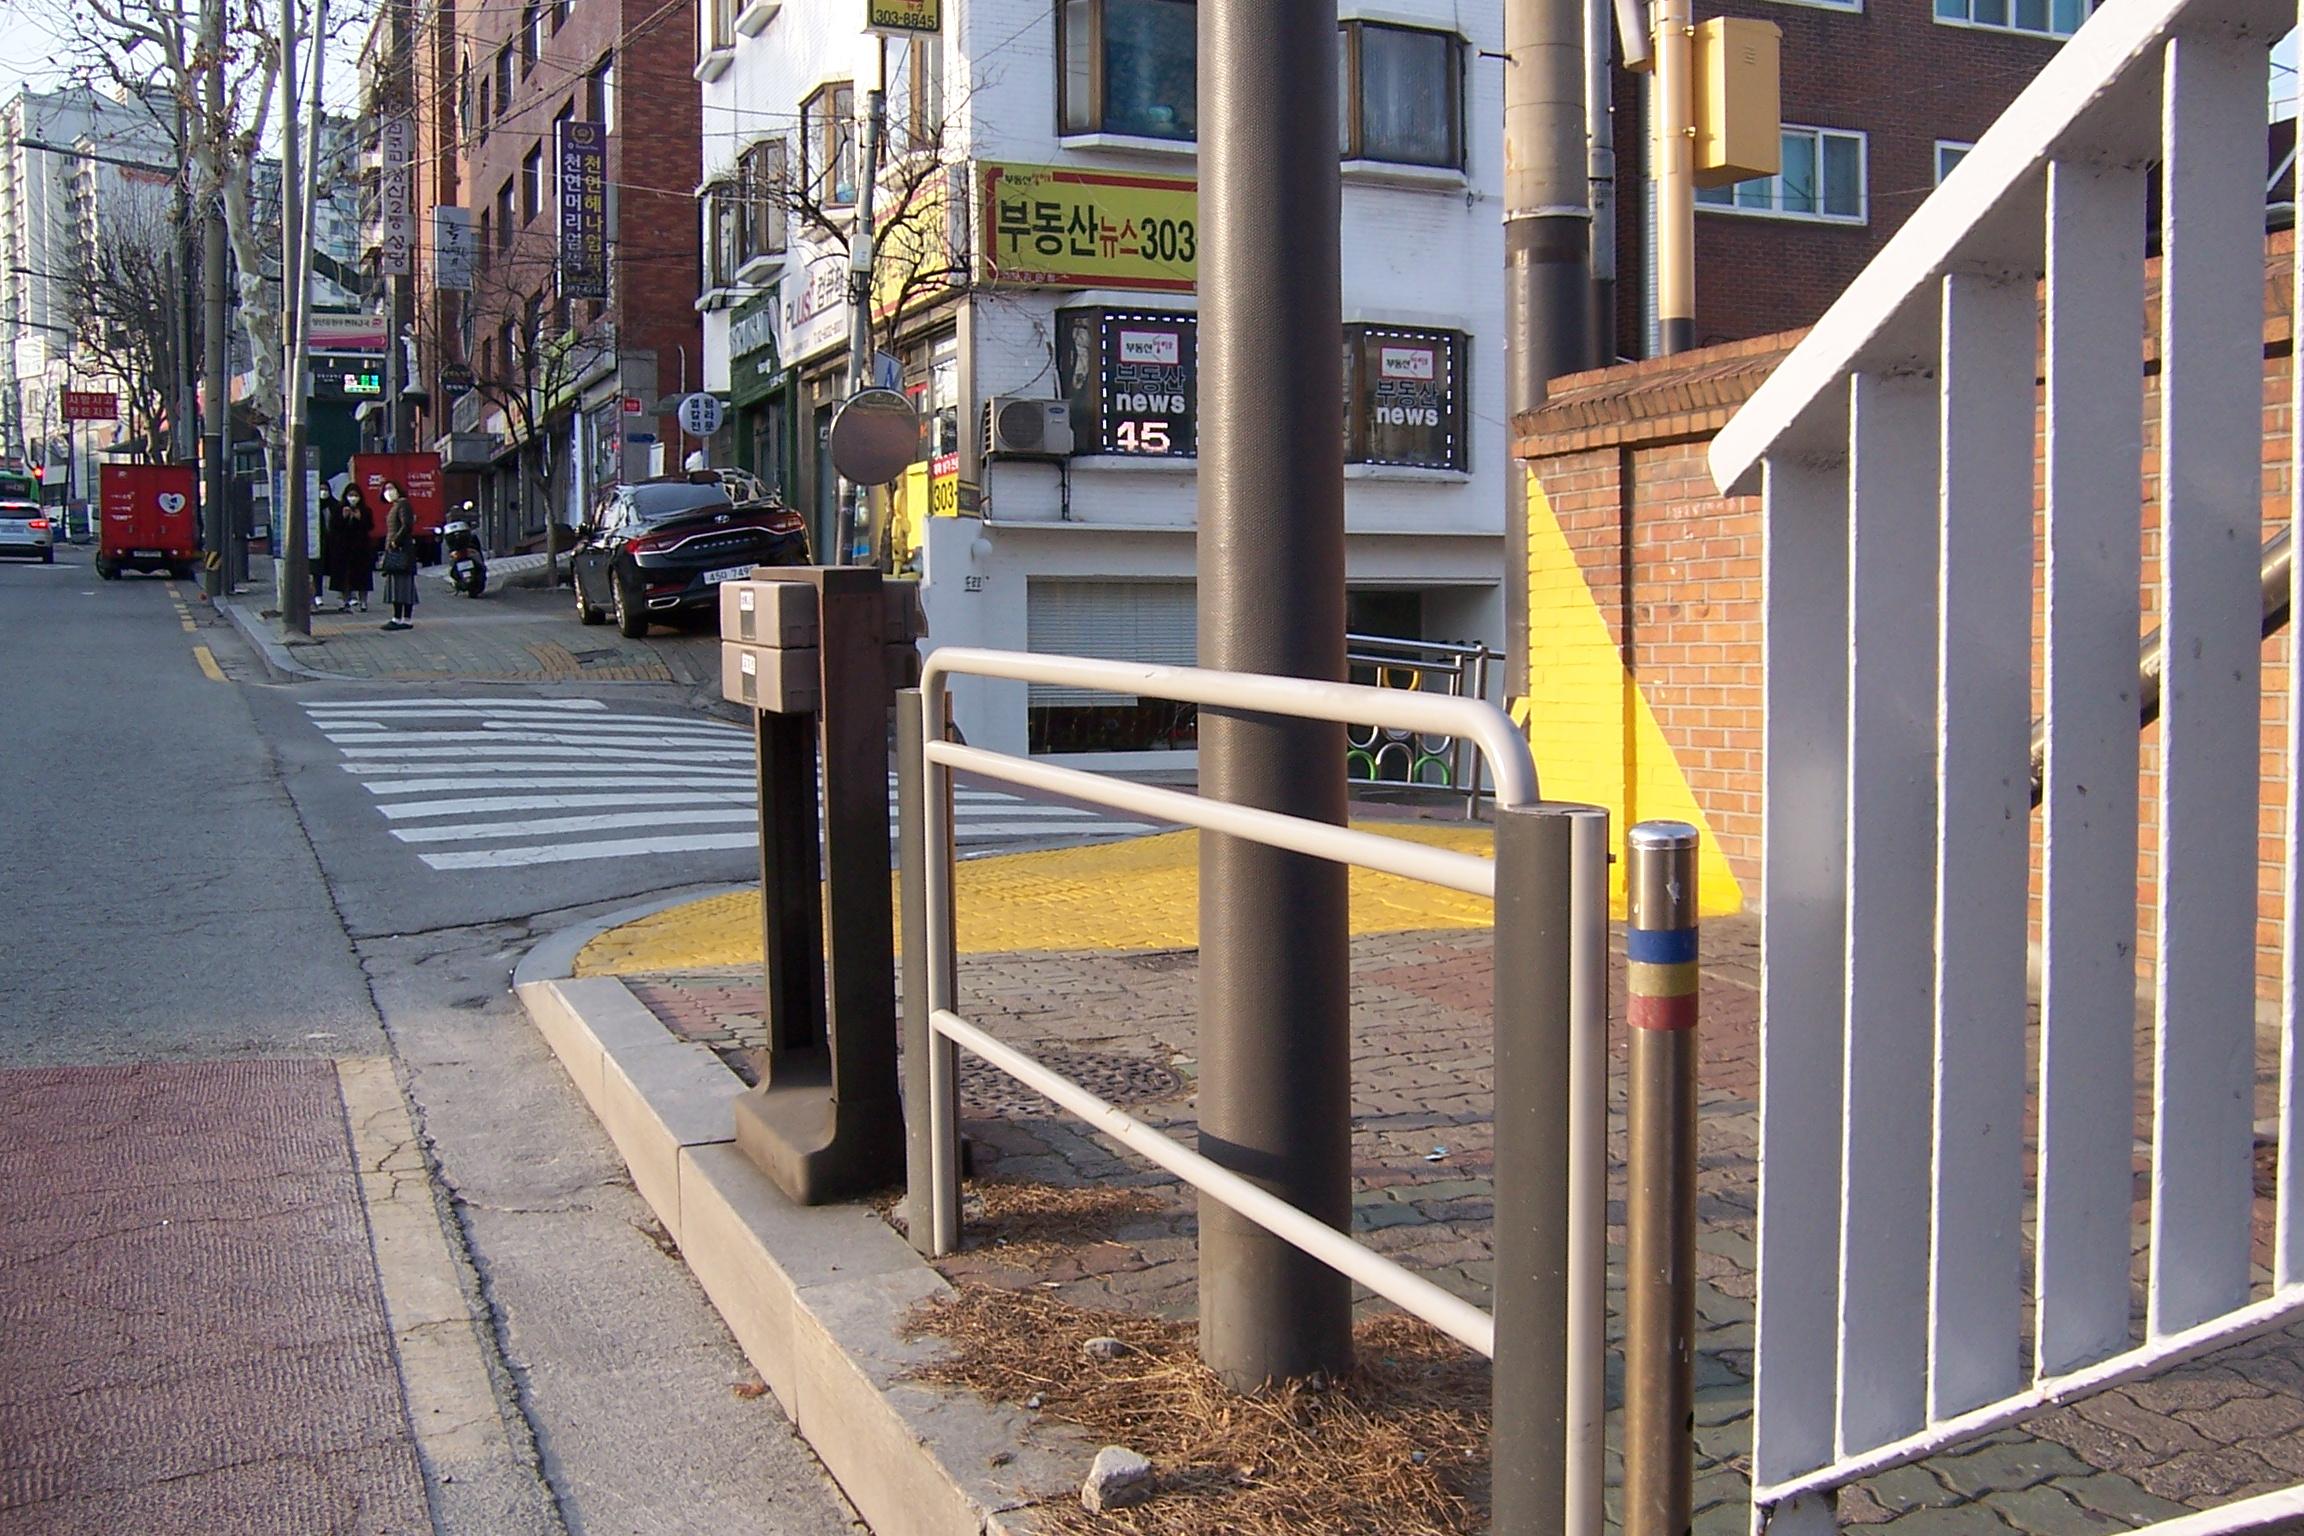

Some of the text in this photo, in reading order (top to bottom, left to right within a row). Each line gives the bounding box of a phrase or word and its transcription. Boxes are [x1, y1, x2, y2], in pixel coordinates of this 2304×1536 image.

[876, 9, 935, 28] 303-8845
[1115, 364, 1186, 393] 부동산
[1116, 393, 1185, 413] news
[1376, 379, 1440, 407] 부동산
[1377, 406, 1438, 426] news
